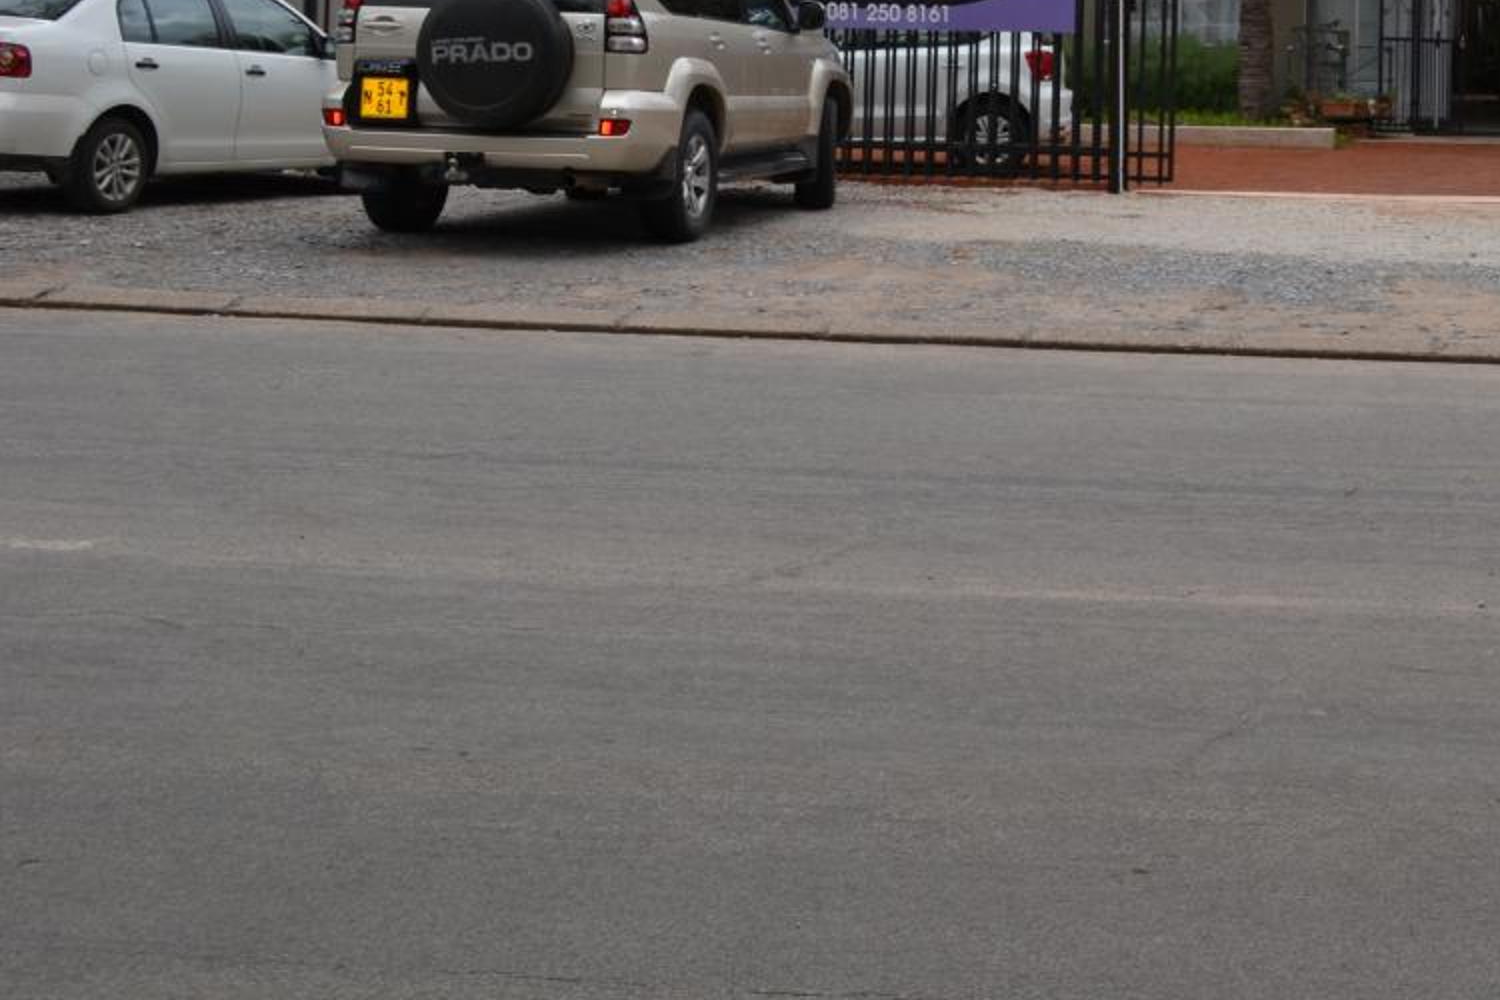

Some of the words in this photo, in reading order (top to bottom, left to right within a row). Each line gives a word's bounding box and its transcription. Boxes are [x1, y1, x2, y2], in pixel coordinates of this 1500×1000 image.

[826, 2, 859, 22] 081
[866, 3, 901, 23] 250
[906, 4, 950, 24] 8161
[432, 41, 533, 64] PRADO
